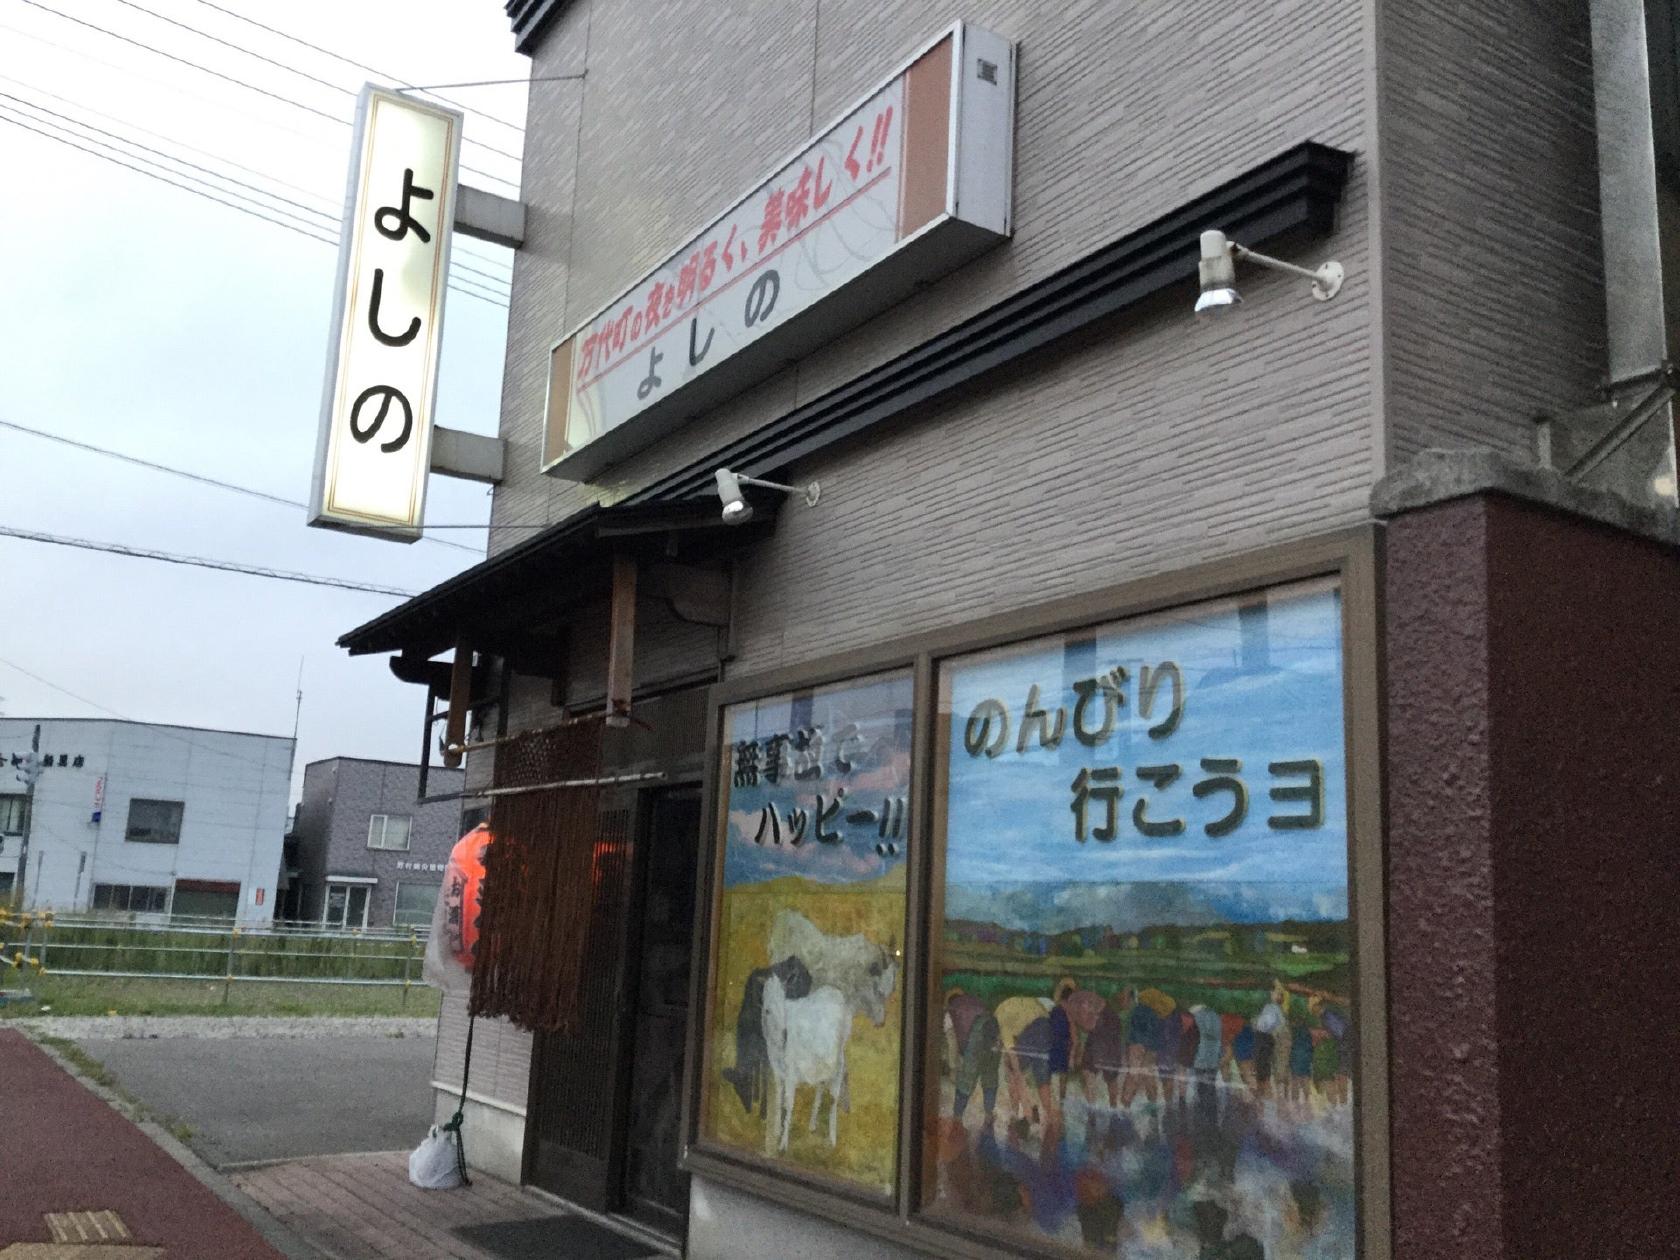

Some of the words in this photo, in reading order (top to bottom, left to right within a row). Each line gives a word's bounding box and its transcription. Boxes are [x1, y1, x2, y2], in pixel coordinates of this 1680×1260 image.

[350, 168, 434, 453] よしの
[637, 269, 780, 400] よしの
[964, 660, 1184, 758] のんびり
[1070, 758, 1325, 842] 行こうヨ
